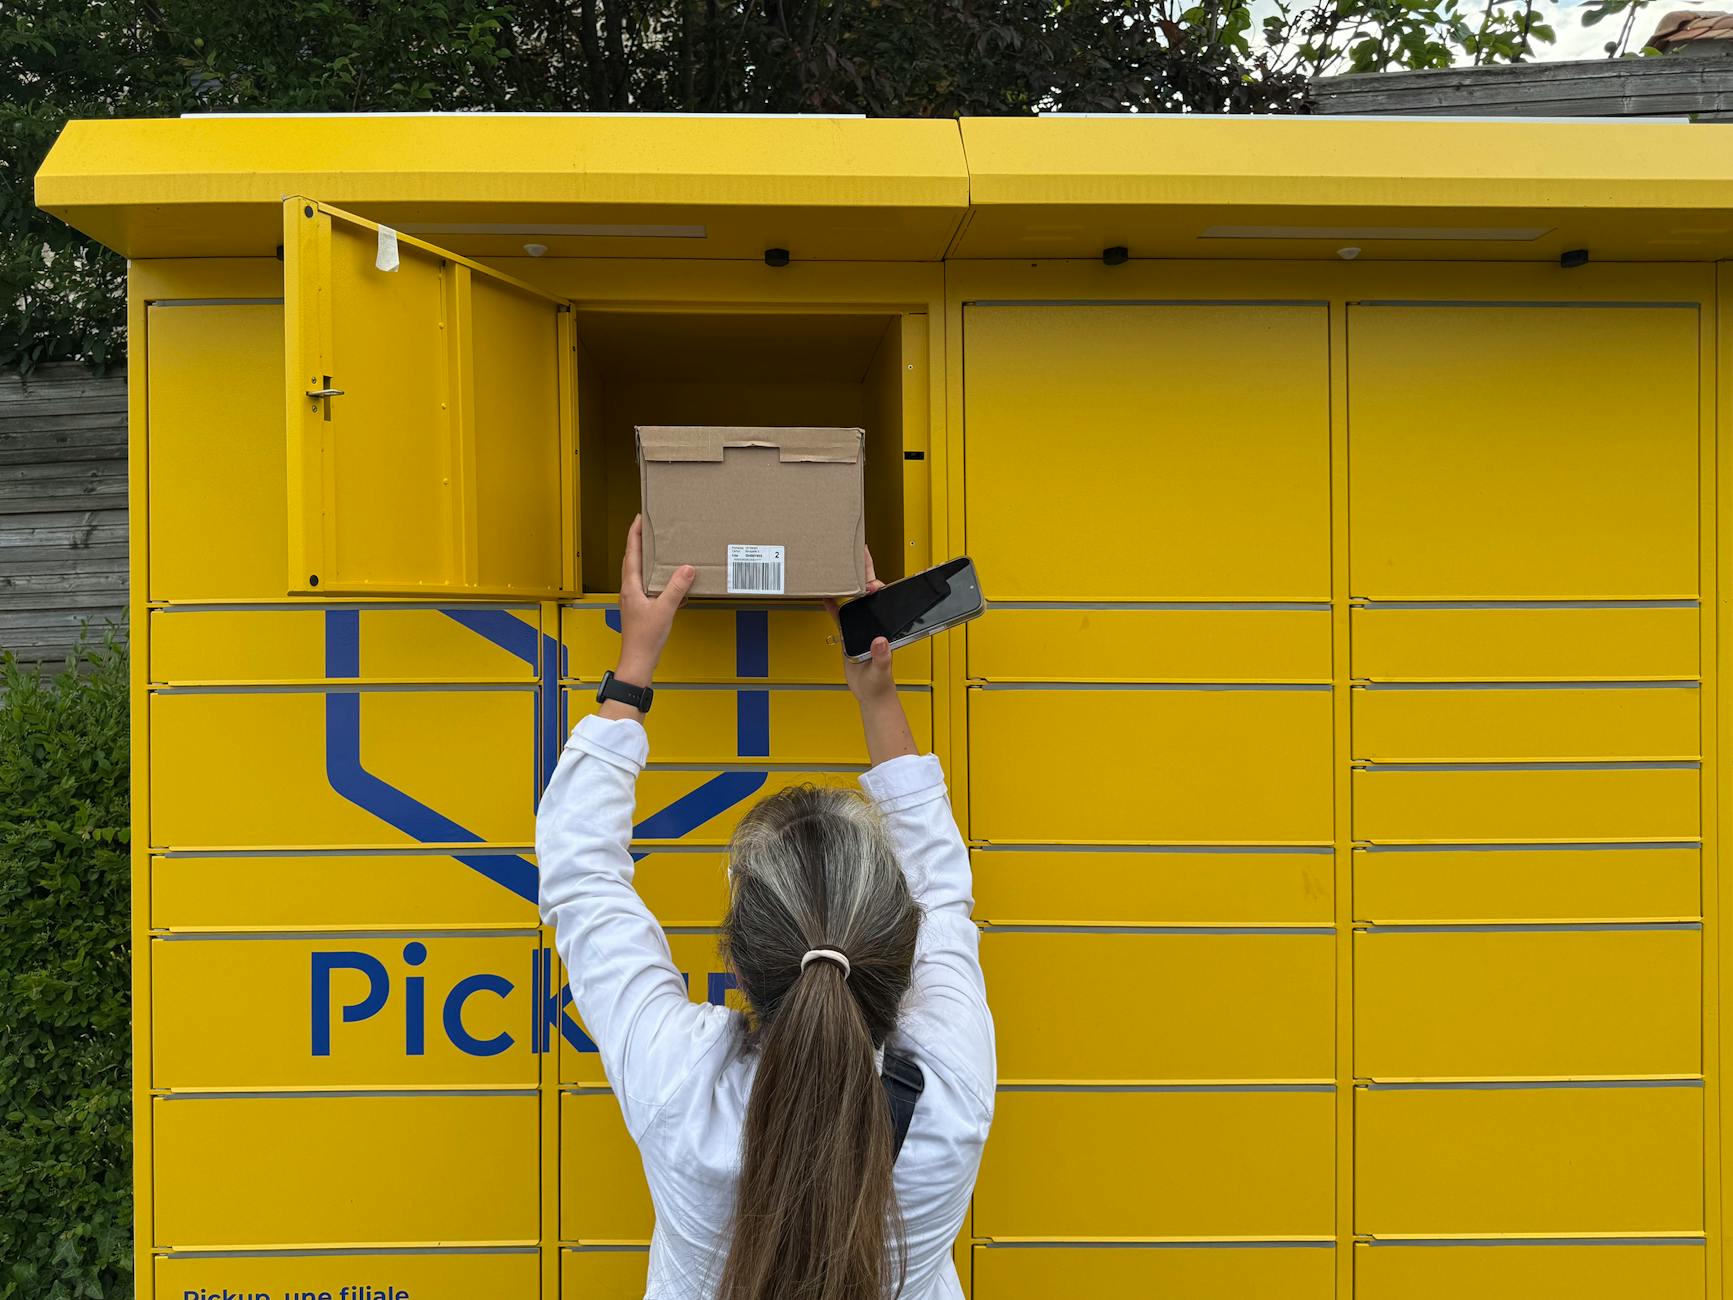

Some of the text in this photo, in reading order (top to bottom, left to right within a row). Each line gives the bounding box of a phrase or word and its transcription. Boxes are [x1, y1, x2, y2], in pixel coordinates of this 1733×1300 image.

[774, 551, 780, 559] 2
[311, 941, 738, 1057] Pick
[339, 1285, 409, 1300] filiale
